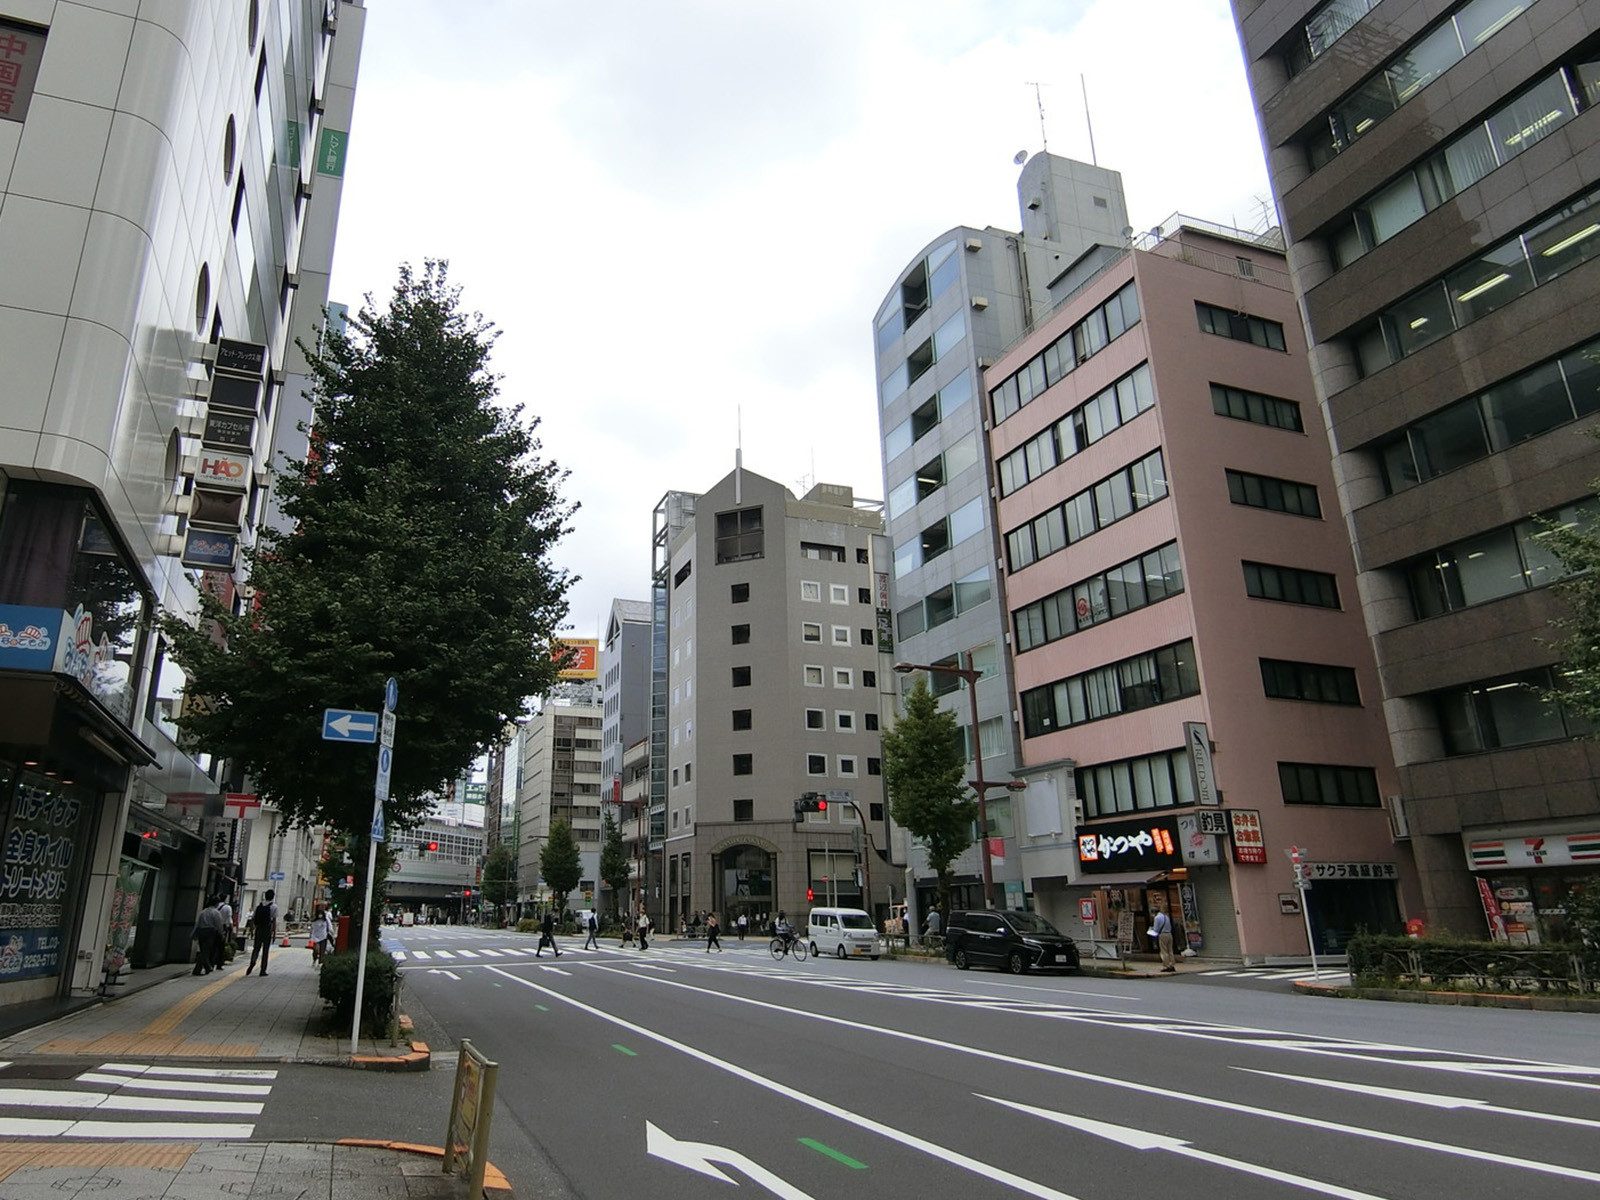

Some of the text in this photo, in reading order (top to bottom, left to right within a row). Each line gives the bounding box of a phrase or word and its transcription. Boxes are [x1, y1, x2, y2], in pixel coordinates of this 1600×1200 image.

[1201, 812, 1226, 831] 釣具
[1233, 813, 1258, 827] お弁当
[5, 826, 74, 869] 全身オイル
[1098, 830, 1153, 859] かつや
[1315, 863, 1395, 878] サクラ高級釣竿
